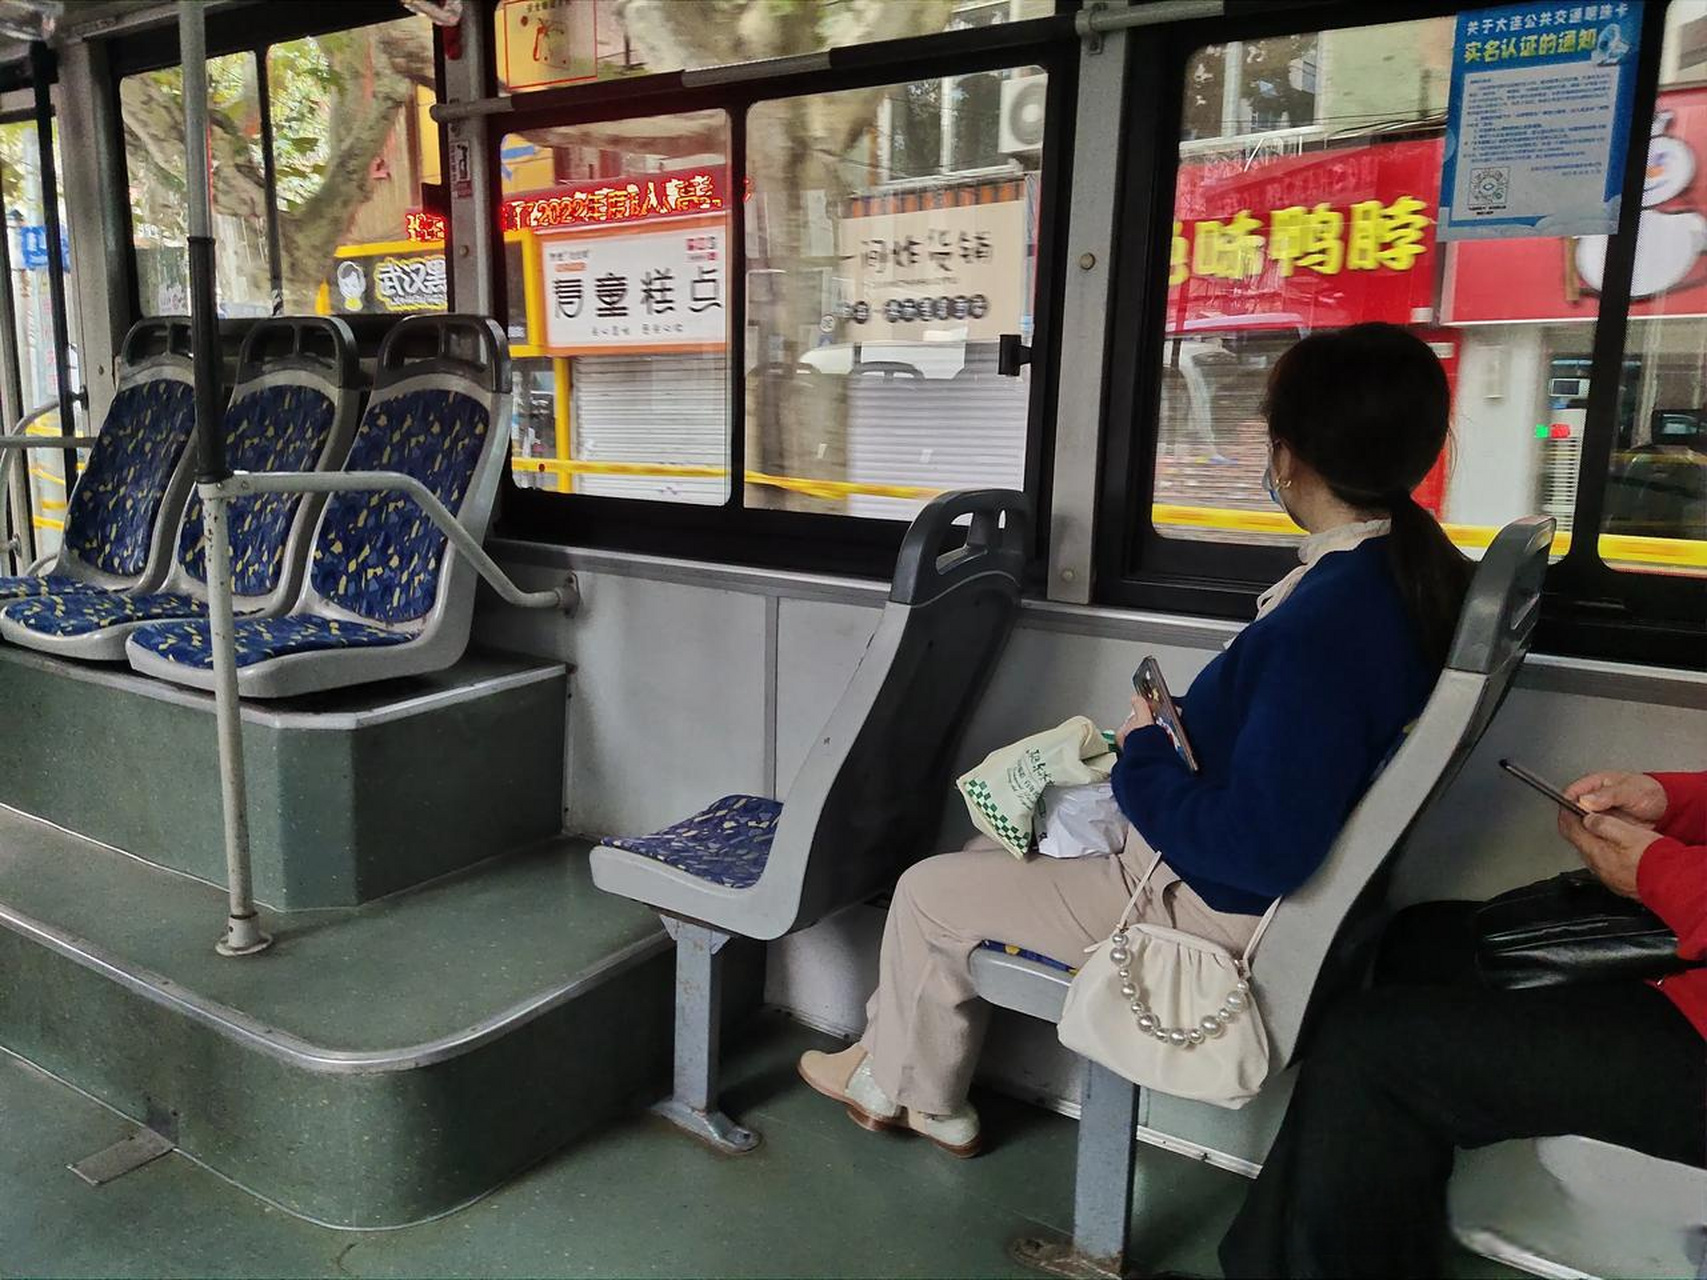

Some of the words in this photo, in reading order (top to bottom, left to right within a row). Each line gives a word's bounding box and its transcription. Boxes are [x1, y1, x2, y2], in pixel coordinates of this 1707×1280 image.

[1464, 28, 1598, 64] 实名认证的通知
